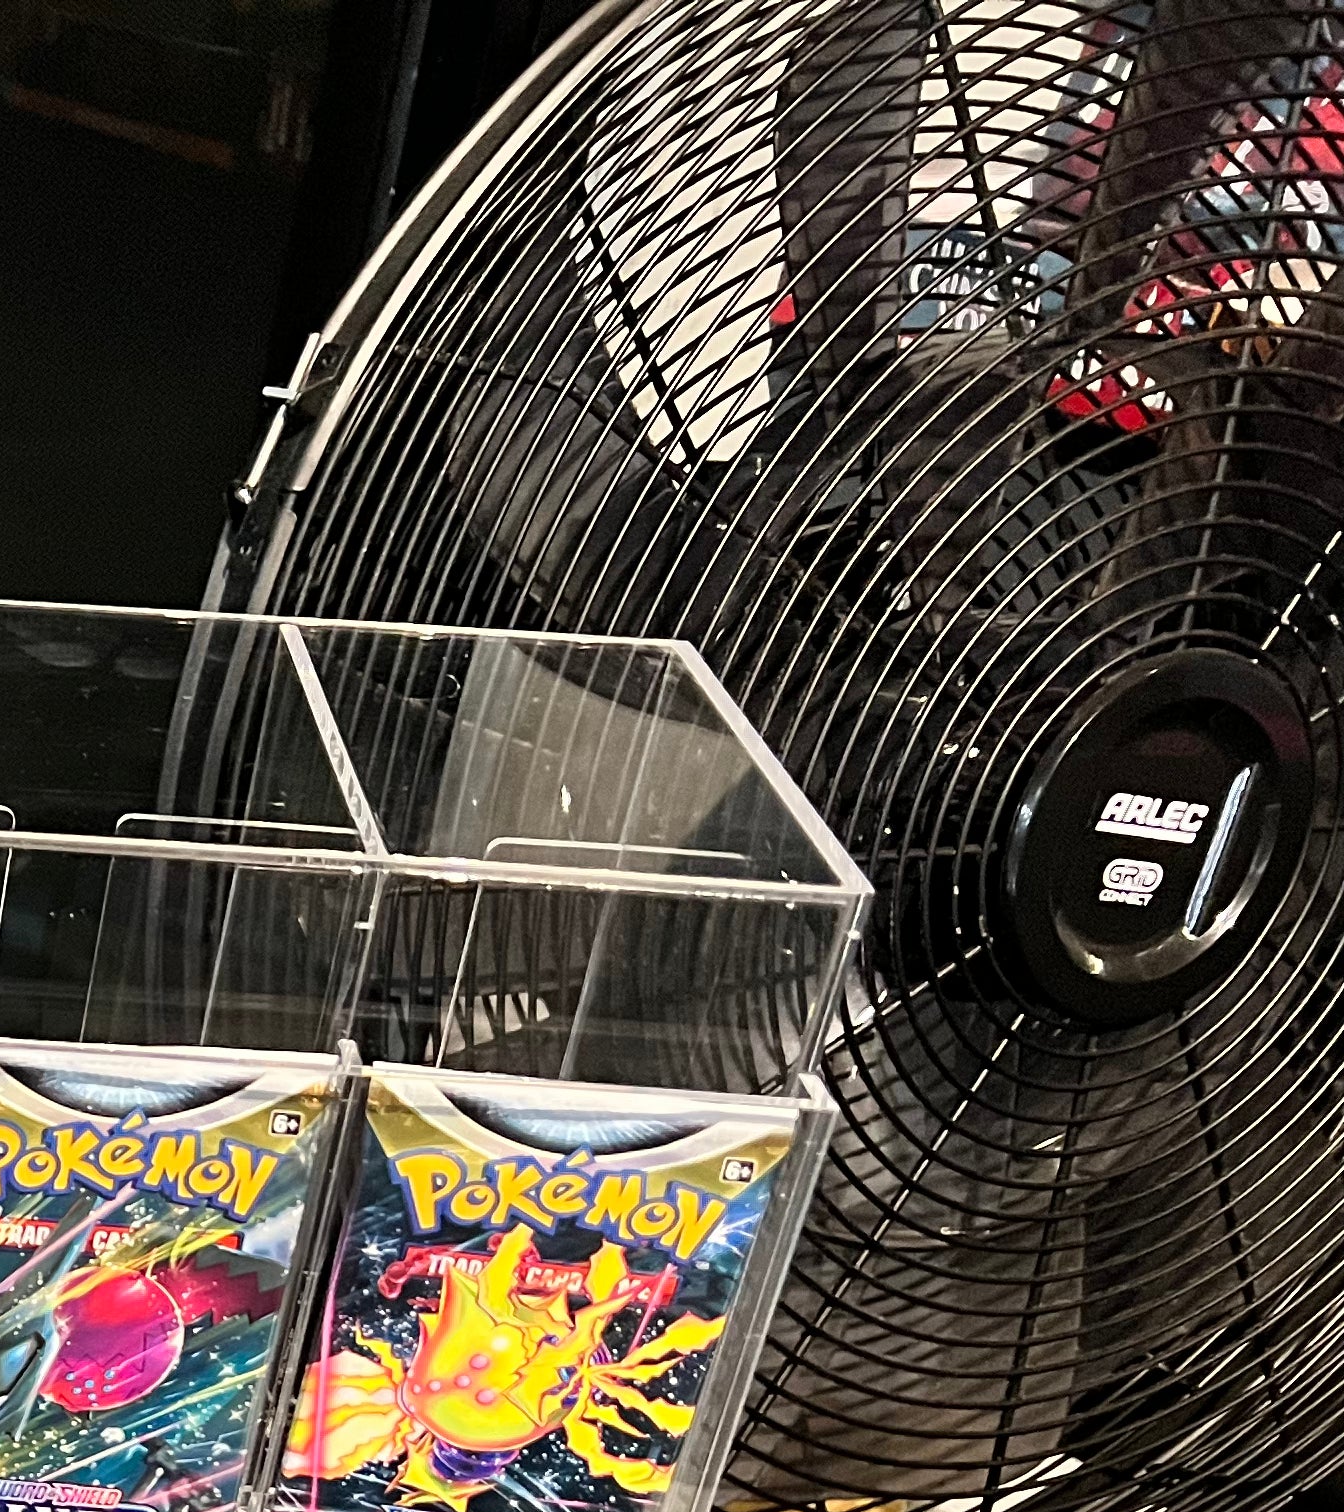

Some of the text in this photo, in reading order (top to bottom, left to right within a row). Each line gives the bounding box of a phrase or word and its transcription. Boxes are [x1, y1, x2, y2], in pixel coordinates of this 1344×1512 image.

[1101, 792, 1210, 832] ARLEC
[273, 1115, 301, 1135] 6+
[725, 1162, 753, 1182] 6+
